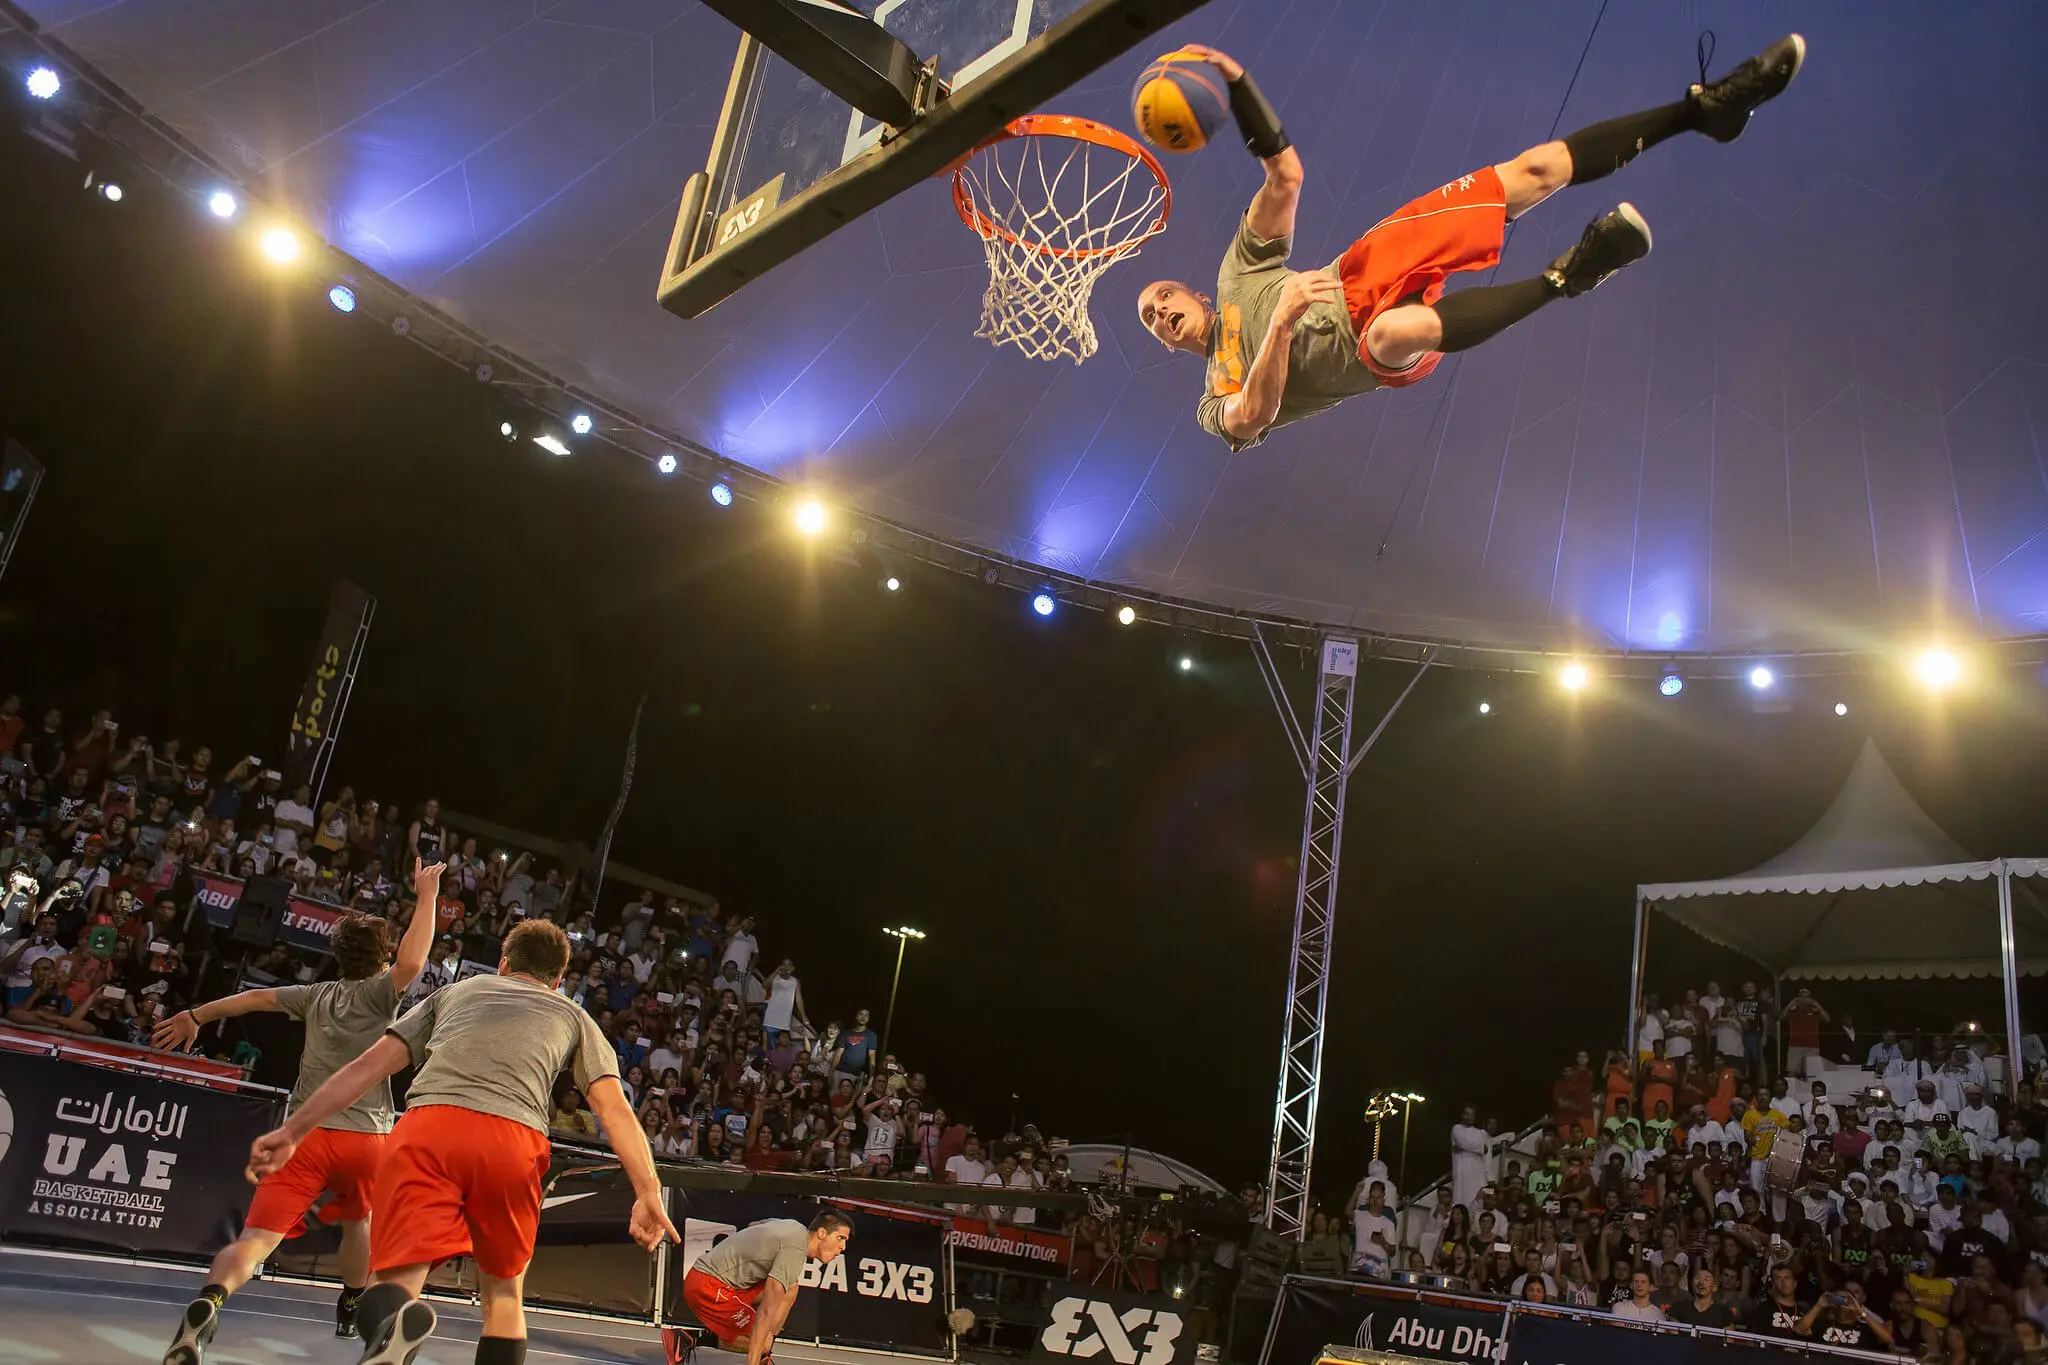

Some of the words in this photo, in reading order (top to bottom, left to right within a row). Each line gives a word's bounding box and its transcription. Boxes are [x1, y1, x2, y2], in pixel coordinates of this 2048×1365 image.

[198, 888, 235, 910] ABU
[296, 915, 340, 937] FINA
[55, 1091, 189, 1141] الإمارات
[872, 1126, 891, 1145] 15
[43, 1133, 178, 1190] UAE
[32, 1179, 166, 1213] BASKETBALL
[27, 1200, 164, 1229] ASSOCIATION
[856, 1256, 936, 1304] 3X3
[1386, 1316, 1445, 1351] Abu
[1451, 1326, 1509, 1361] Dha
